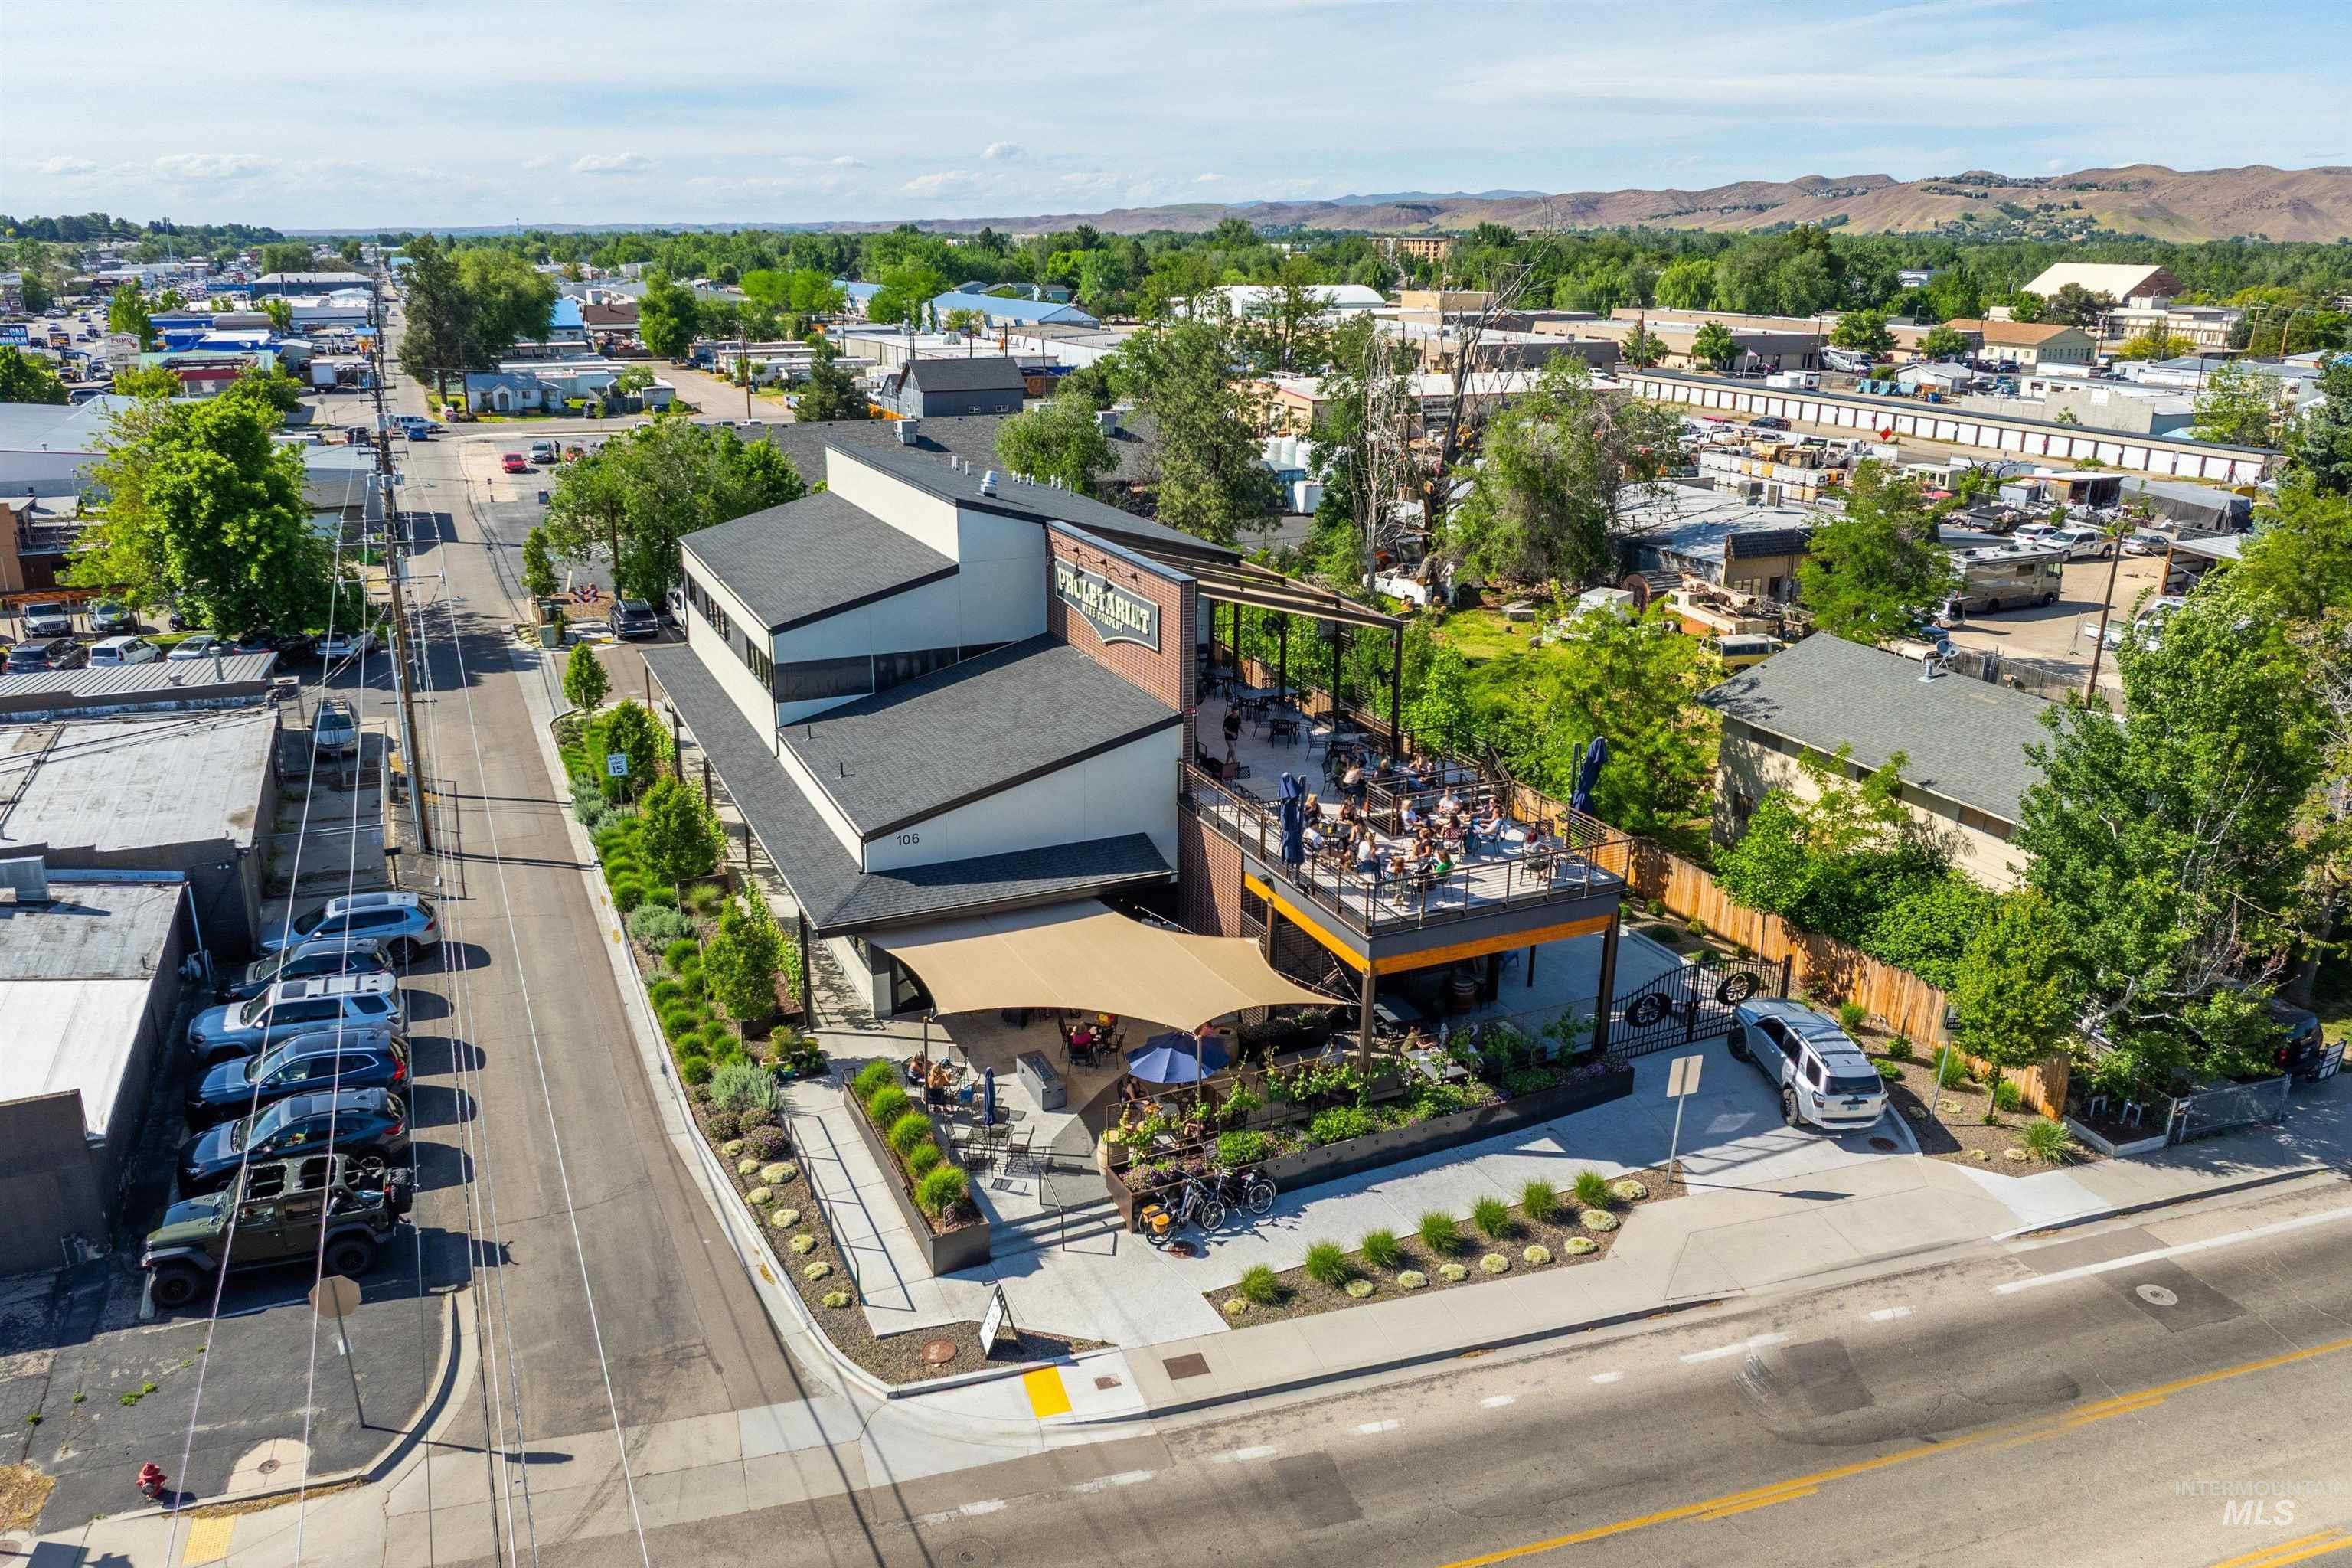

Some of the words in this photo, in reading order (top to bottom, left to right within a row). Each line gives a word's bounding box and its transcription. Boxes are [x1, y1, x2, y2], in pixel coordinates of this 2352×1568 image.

[9, 328, 26, 336] CAR
[0, 336, 28, 345] WASH
[1057, 567, 1152, 635] PROLETARIAT
[1081, 602, 1096, 619] WINE
[1097, 612, 1125, 634] COMPANY
[612, 765, 624, 774] 15
[897, 833, 920, 846] 106
